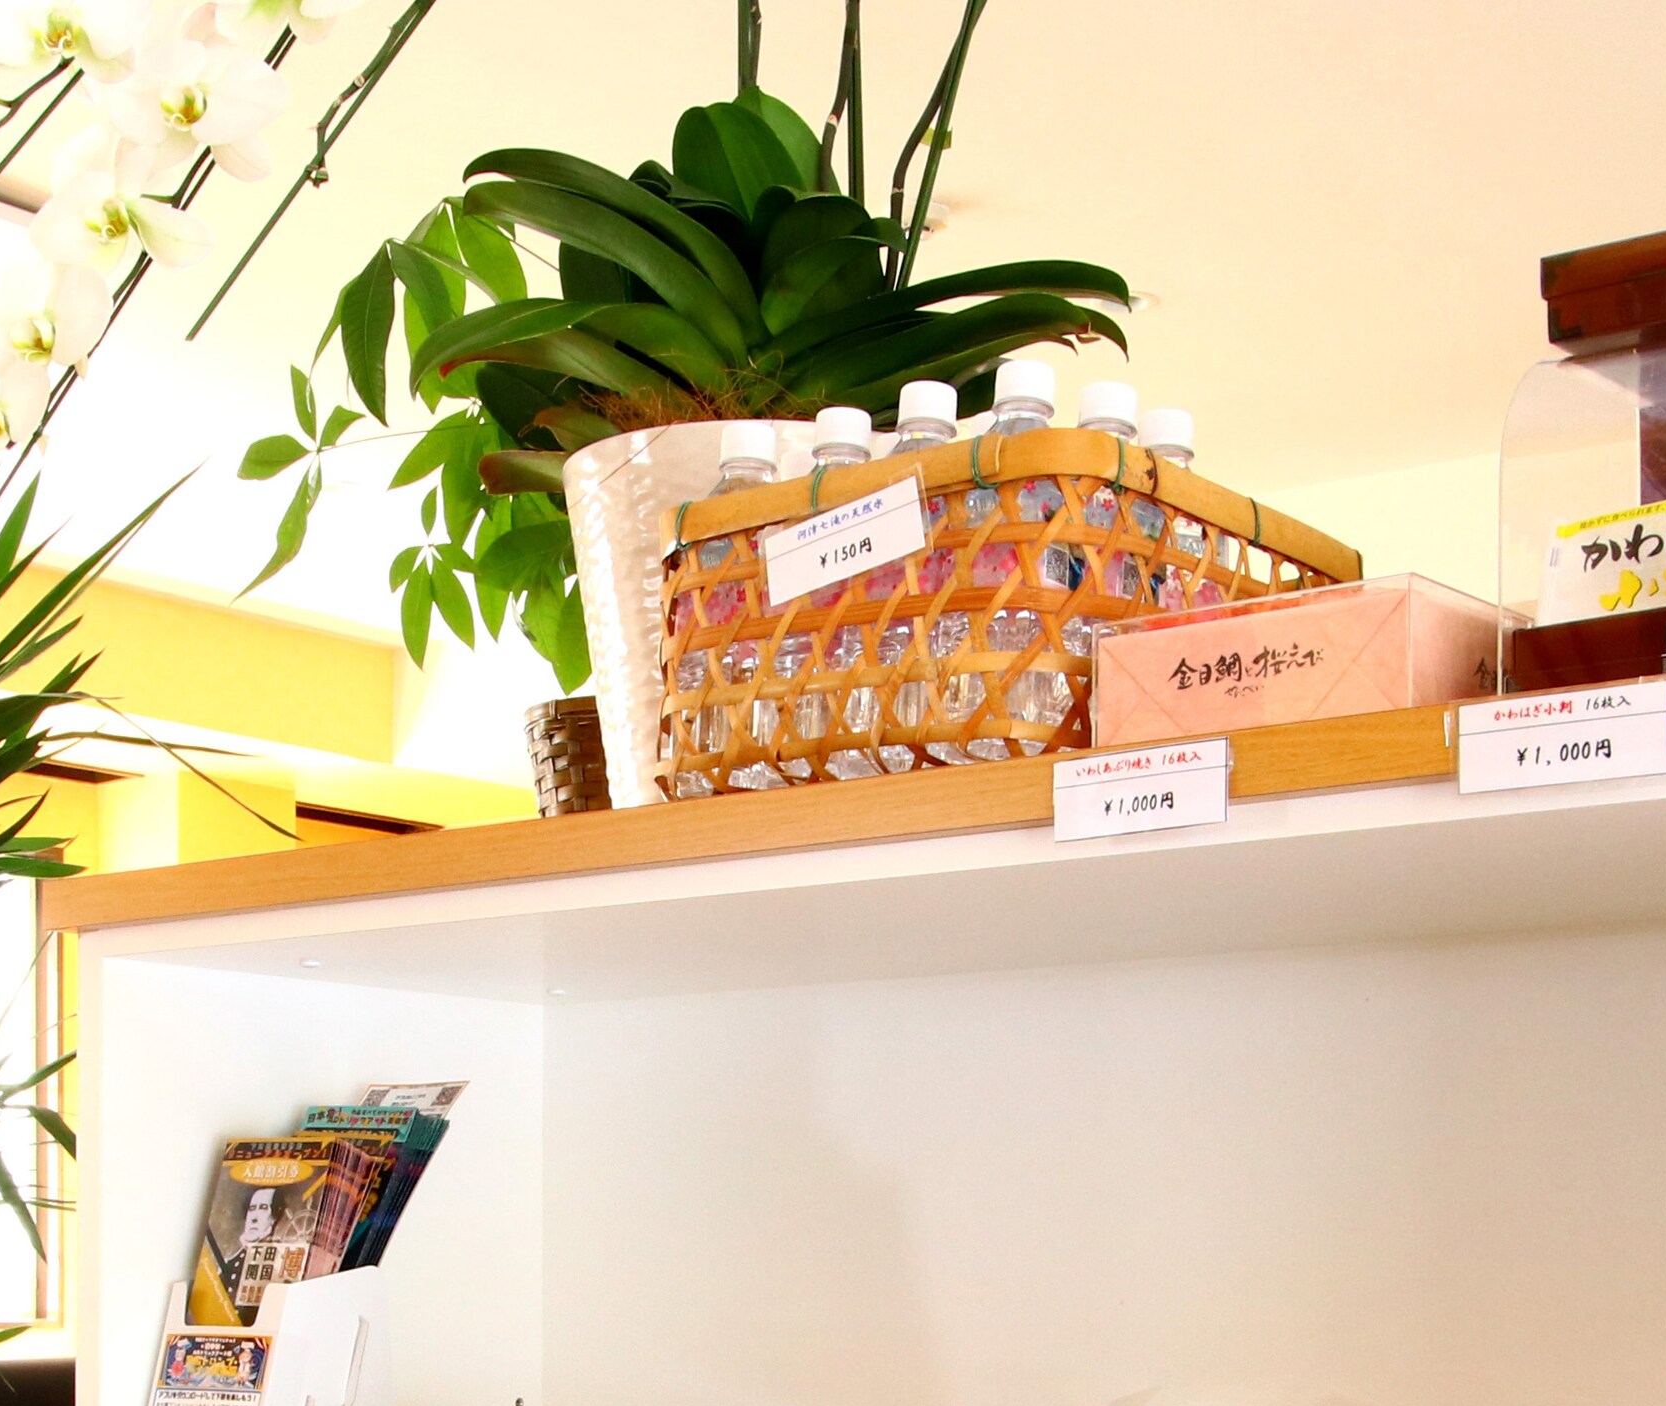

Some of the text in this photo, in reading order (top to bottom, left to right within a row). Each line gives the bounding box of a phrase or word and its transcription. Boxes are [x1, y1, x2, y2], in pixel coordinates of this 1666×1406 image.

[1168, 642, 1324, 690] 金目鯛と桜えび
[1494, 695, 1631, 722] かわはぎ小判 16枚入
[1076, 751, 1202, 777] いわしあぶり焼き 16枚入
